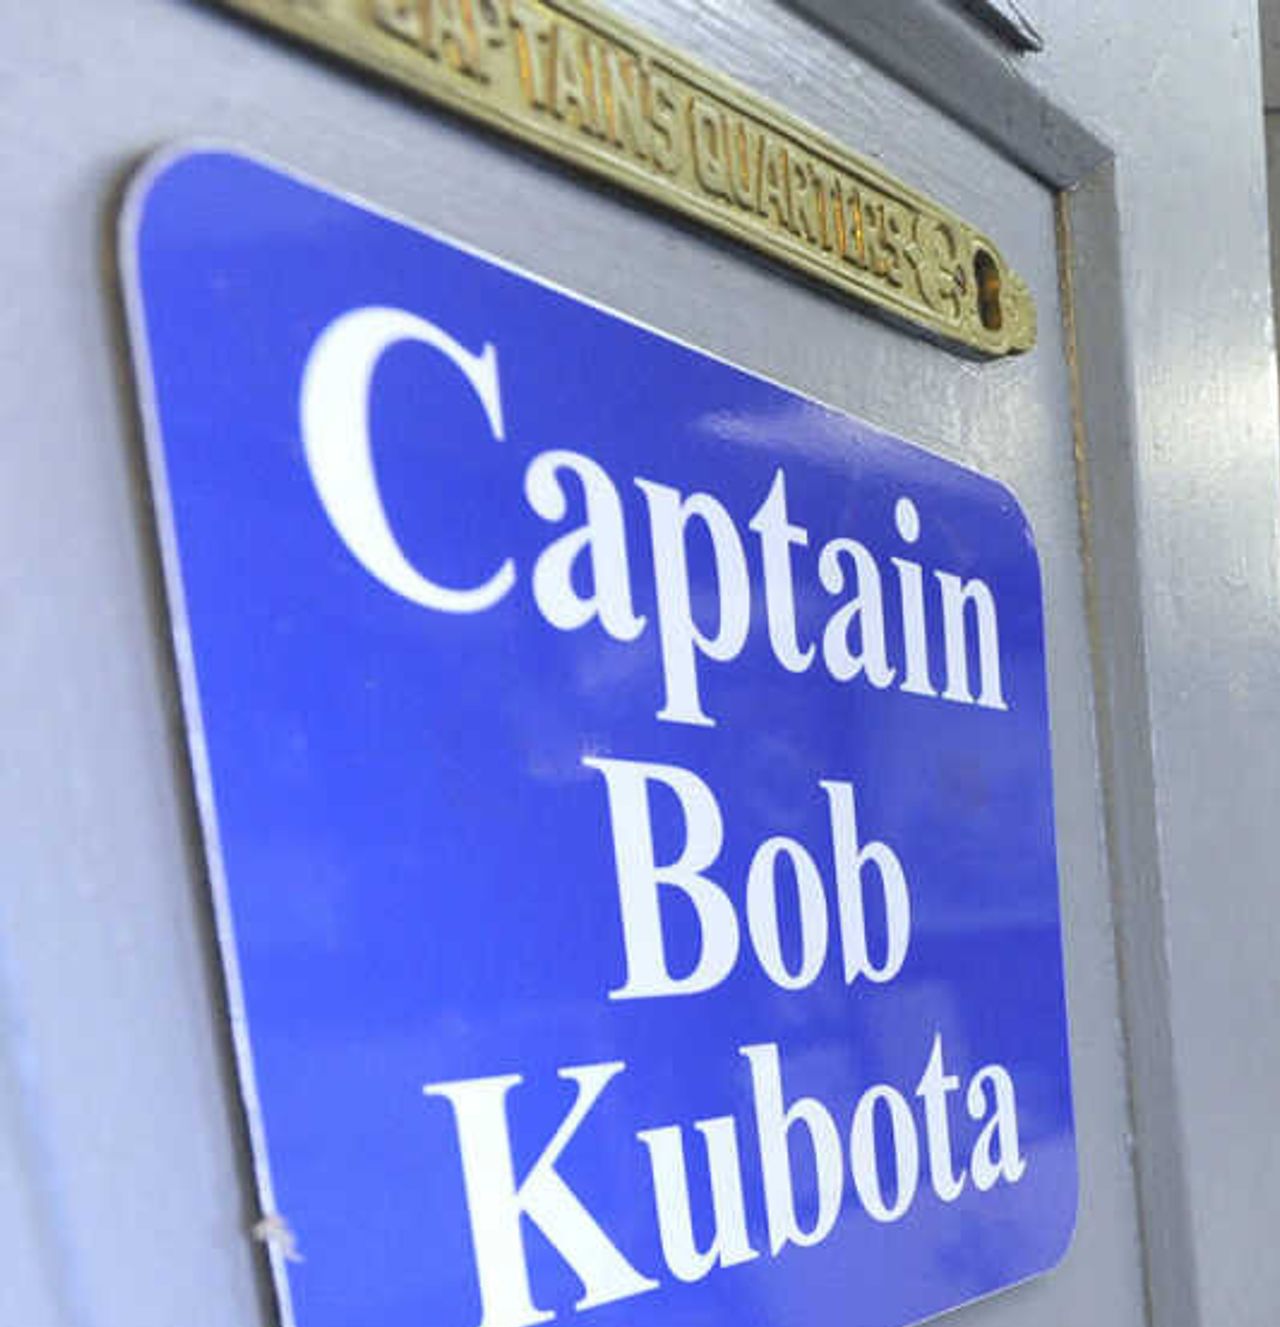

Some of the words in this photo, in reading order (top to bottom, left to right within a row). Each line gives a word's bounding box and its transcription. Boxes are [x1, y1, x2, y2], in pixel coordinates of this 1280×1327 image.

[684, 96, 903, 288] QUARTERS
[301, 308, 1009, 727] Captain
[581, 755, 912, 1000] Bob
